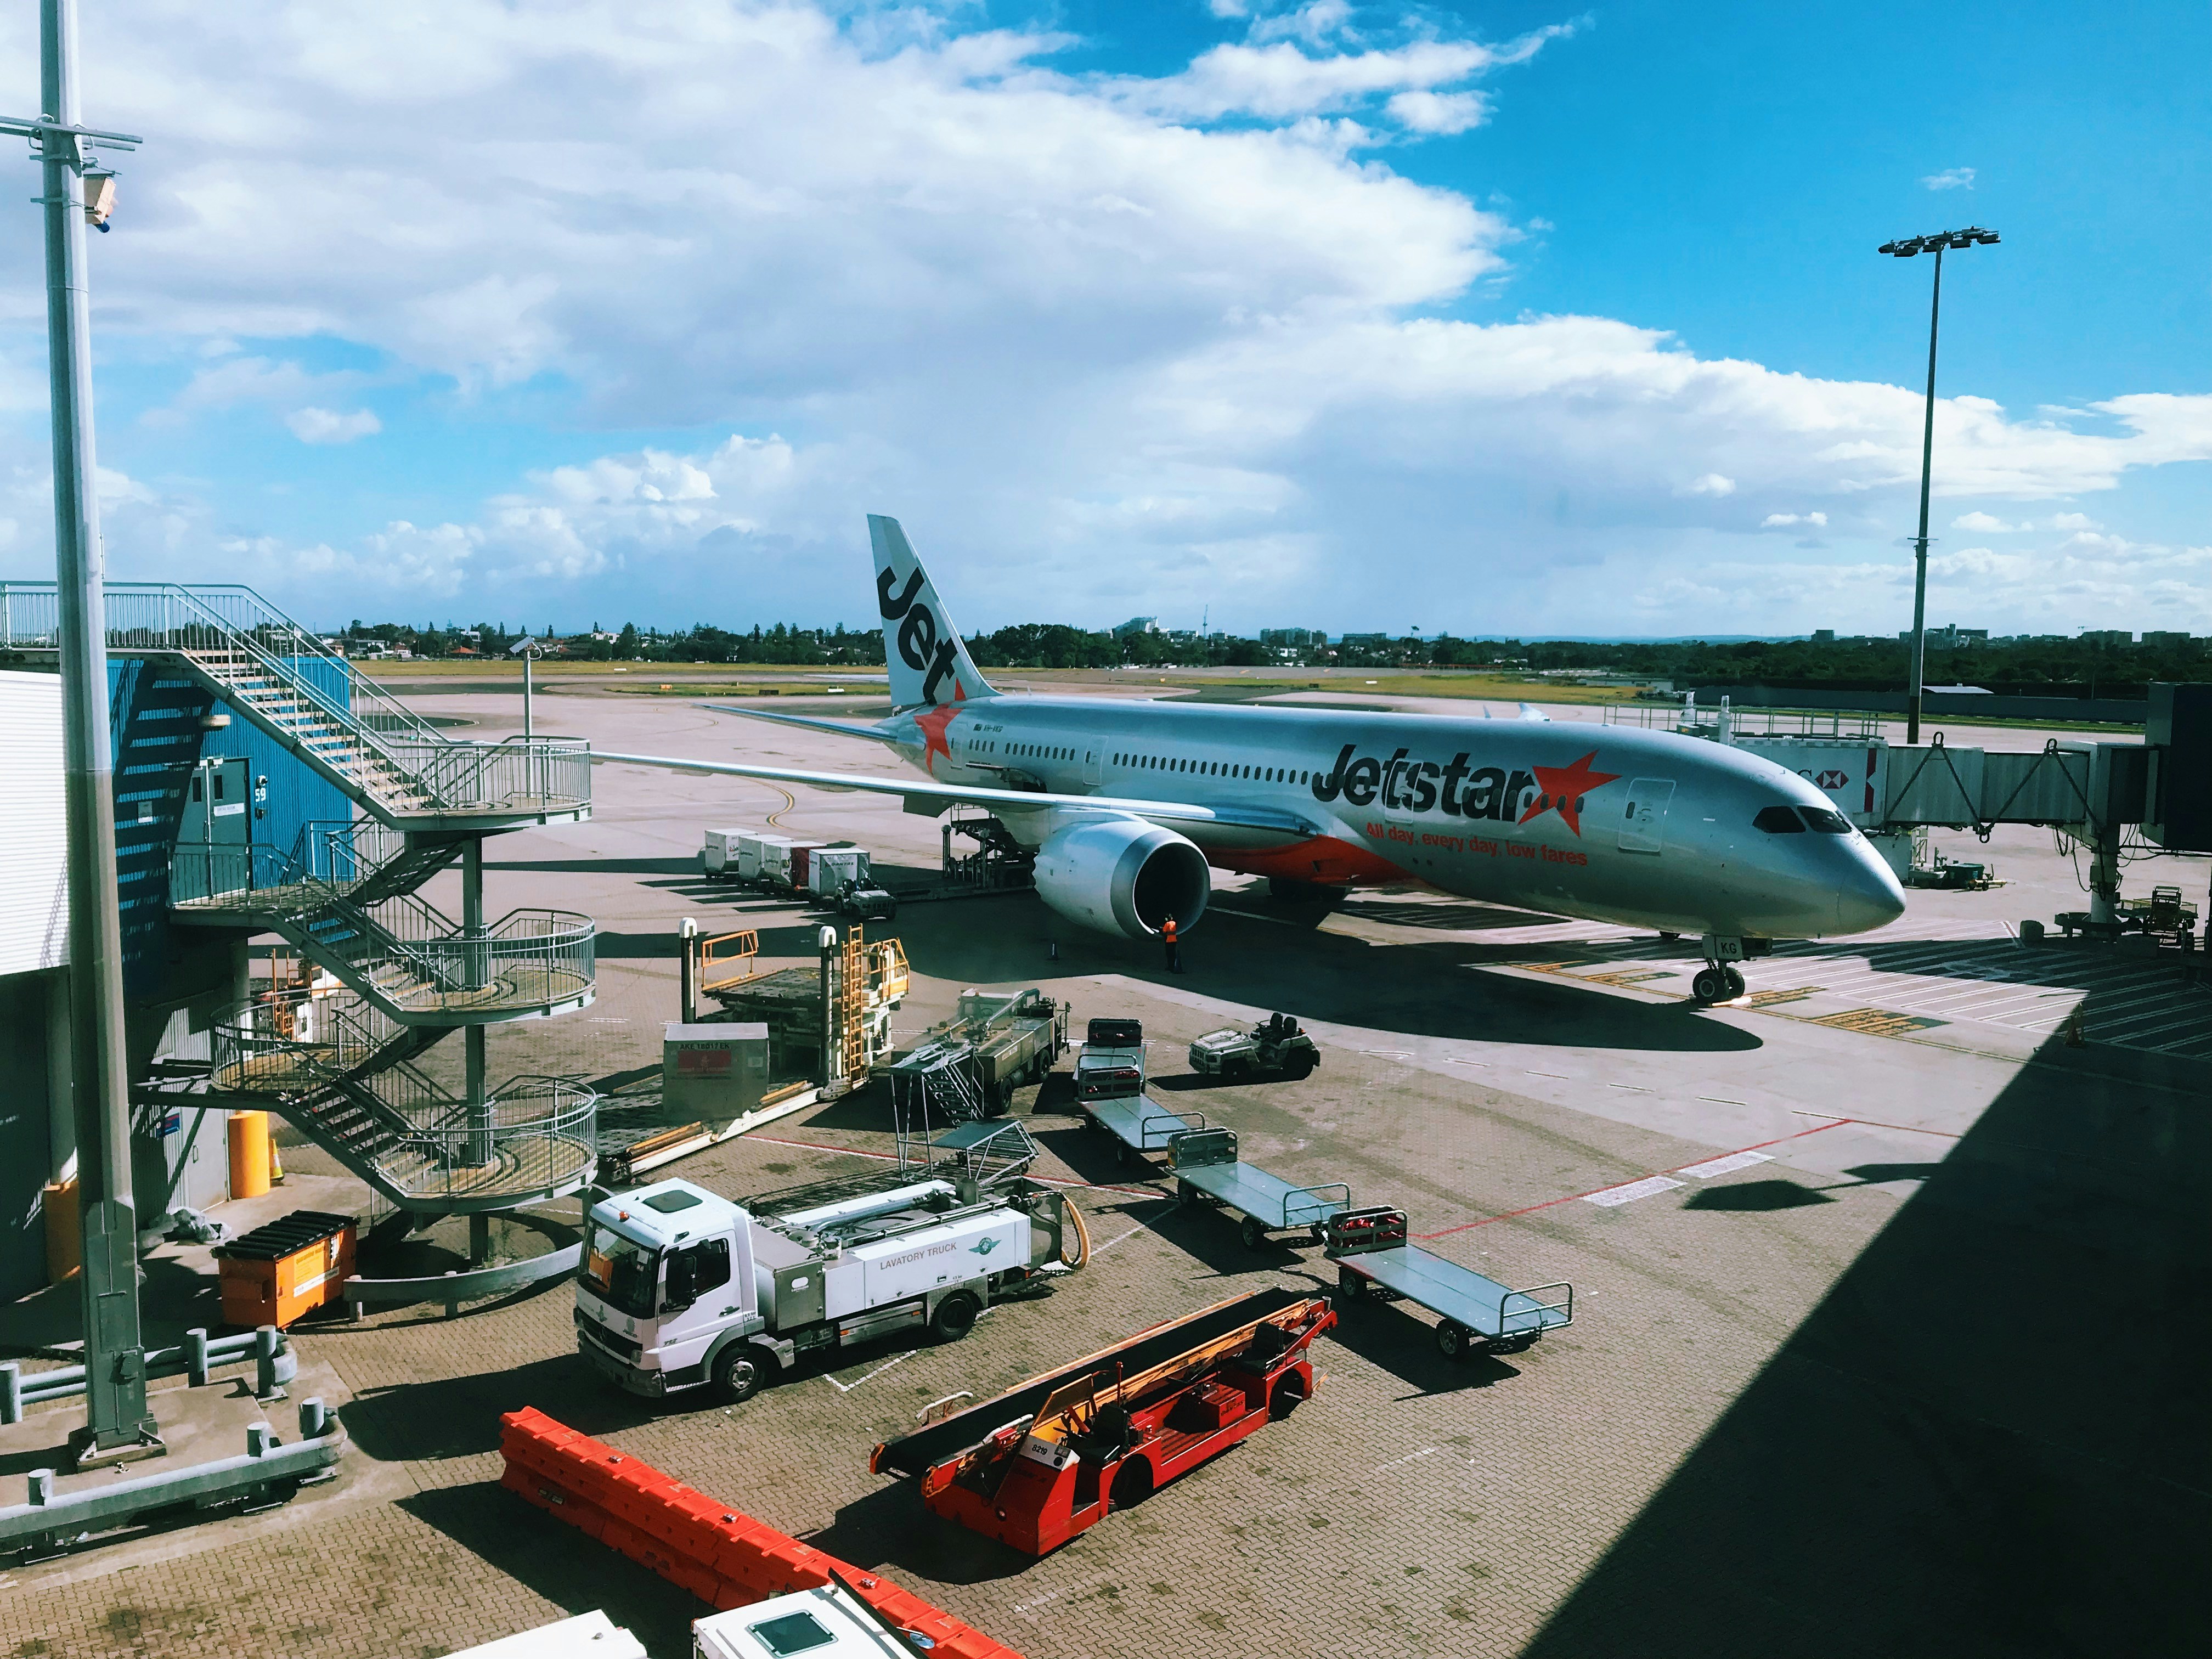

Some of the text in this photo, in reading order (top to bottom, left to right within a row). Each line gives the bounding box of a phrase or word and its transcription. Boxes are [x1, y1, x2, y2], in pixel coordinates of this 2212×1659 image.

[877, 566, 958, 706] Jet
[255, 787, 266, 803] 59
[1312, 744, 1536, 822] Jetstar
[1367, 822, 1385, 839] All
[1422, 832, 1464, 853] every
[1506, 840, 1536, 859] low
[1541, 844, 1588, 867] fares
[1720, 941, 1737, 954] KG
[880, 1242, 957, 1270] LAVATORY TRUCK
[1031, 1444, 1048, 1455] 8219
